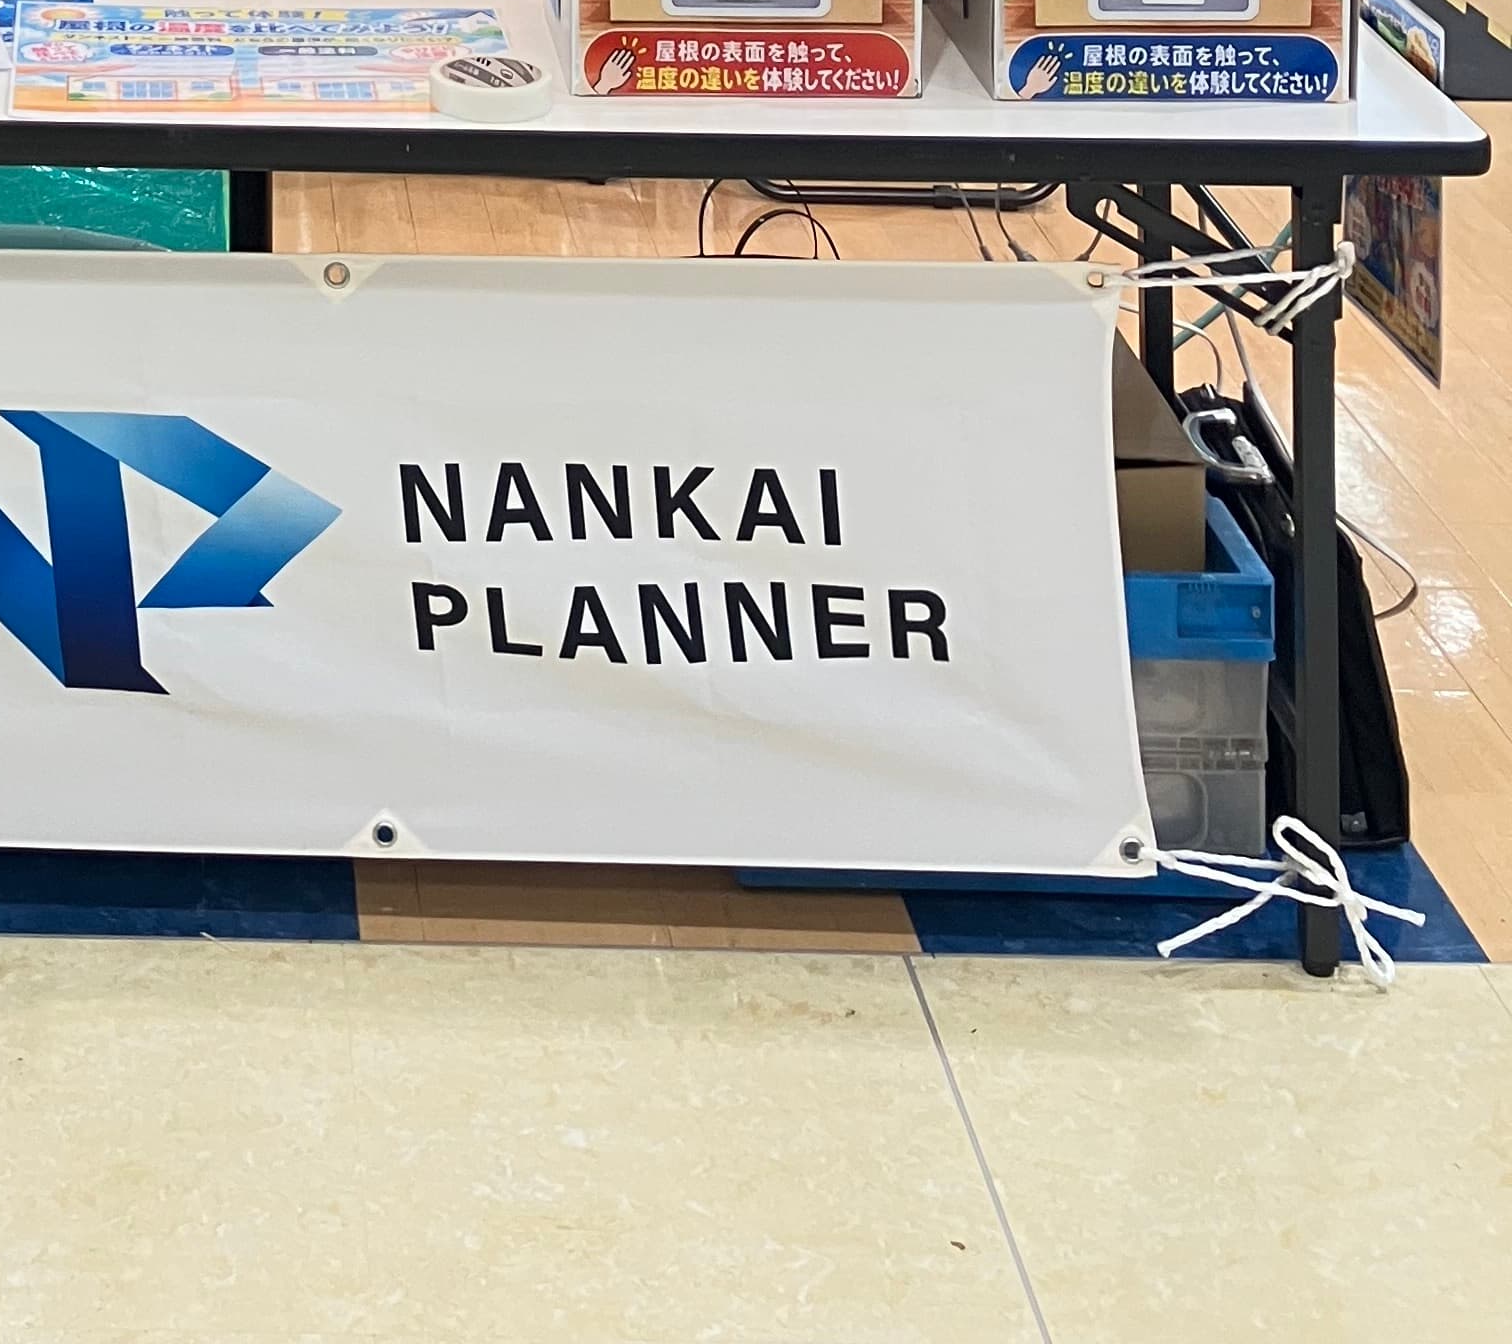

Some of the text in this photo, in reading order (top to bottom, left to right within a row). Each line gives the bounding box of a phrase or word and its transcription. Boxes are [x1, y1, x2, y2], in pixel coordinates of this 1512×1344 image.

[655, 40, 854, 65] 屋根の表面を触って、
[1083, 44, 1280, 68] 屋根の表面を触って、
[636, 67, 899, 92] 温度の違いを体験してください！
[1063, 70, 1329, 95] 温度の違いを体験してください！
[399, 462, 843, 546] NANKAI
[412, 580, 952, 665] PLANNER
